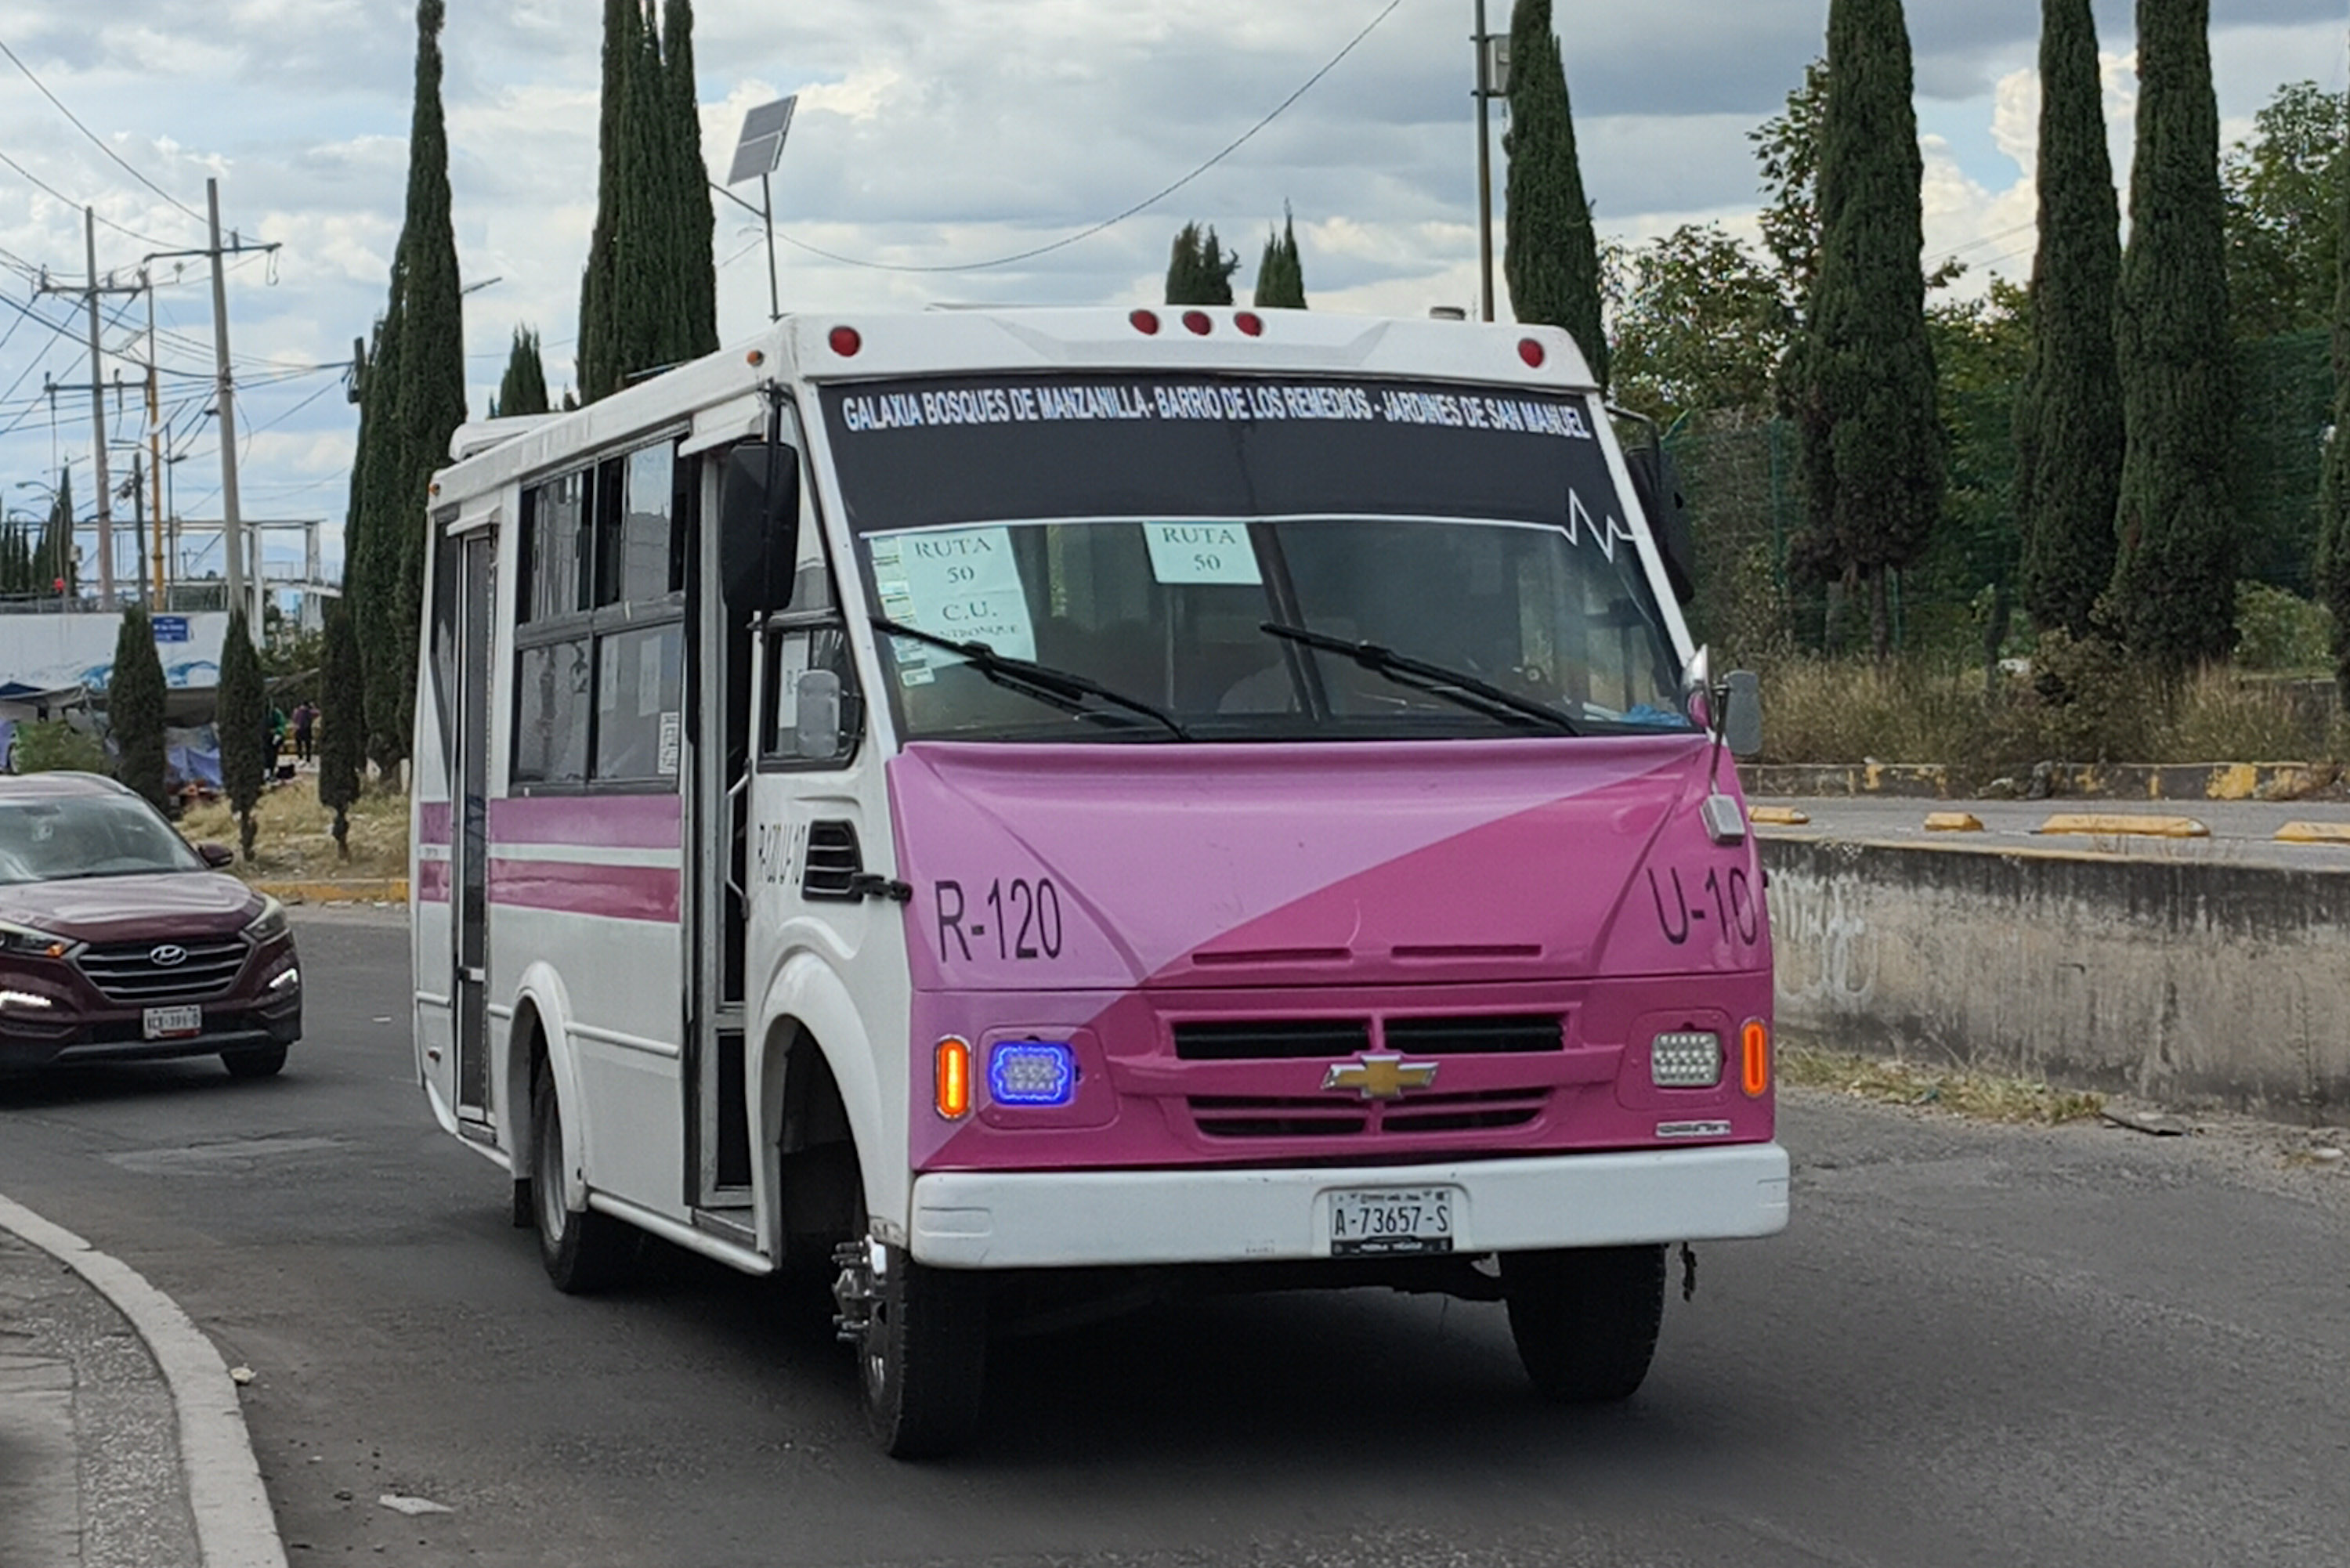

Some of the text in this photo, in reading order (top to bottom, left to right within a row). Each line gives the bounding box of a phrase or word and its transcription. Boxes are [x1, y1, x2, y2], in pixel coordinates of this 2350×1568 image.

[842, 394, 924, 432] GALAXIA
[921, 388, 1010, 425] BOSQUES
[1008, 388, 1039, 421] DE
[1154, 386, 1222, 420] BARRIO
[1220, 386, 1250, 420] DE
[1245, 385, 1286, 420] LOS
[1282, 386, 1373, 421] REMEDIOS
[1459, 396, 1489, 428] DE
[1484, 398, 1525, 432] SAN
[1520, 401, 1592, 439] MANUEL
[1161, 526, 1237, 545] RUTA
[915, 537, 992, 559] RUTA
[1193, 552, 1221, 572] 50
[946, 565, 974, 584] 50
[942, 600, 998, 622] C.U.
[1647, 866, 1758, 946] U-10
[935, 876, 1062, 963] R-120
[1334, 1204, 1448, 1236] A-73657-S
